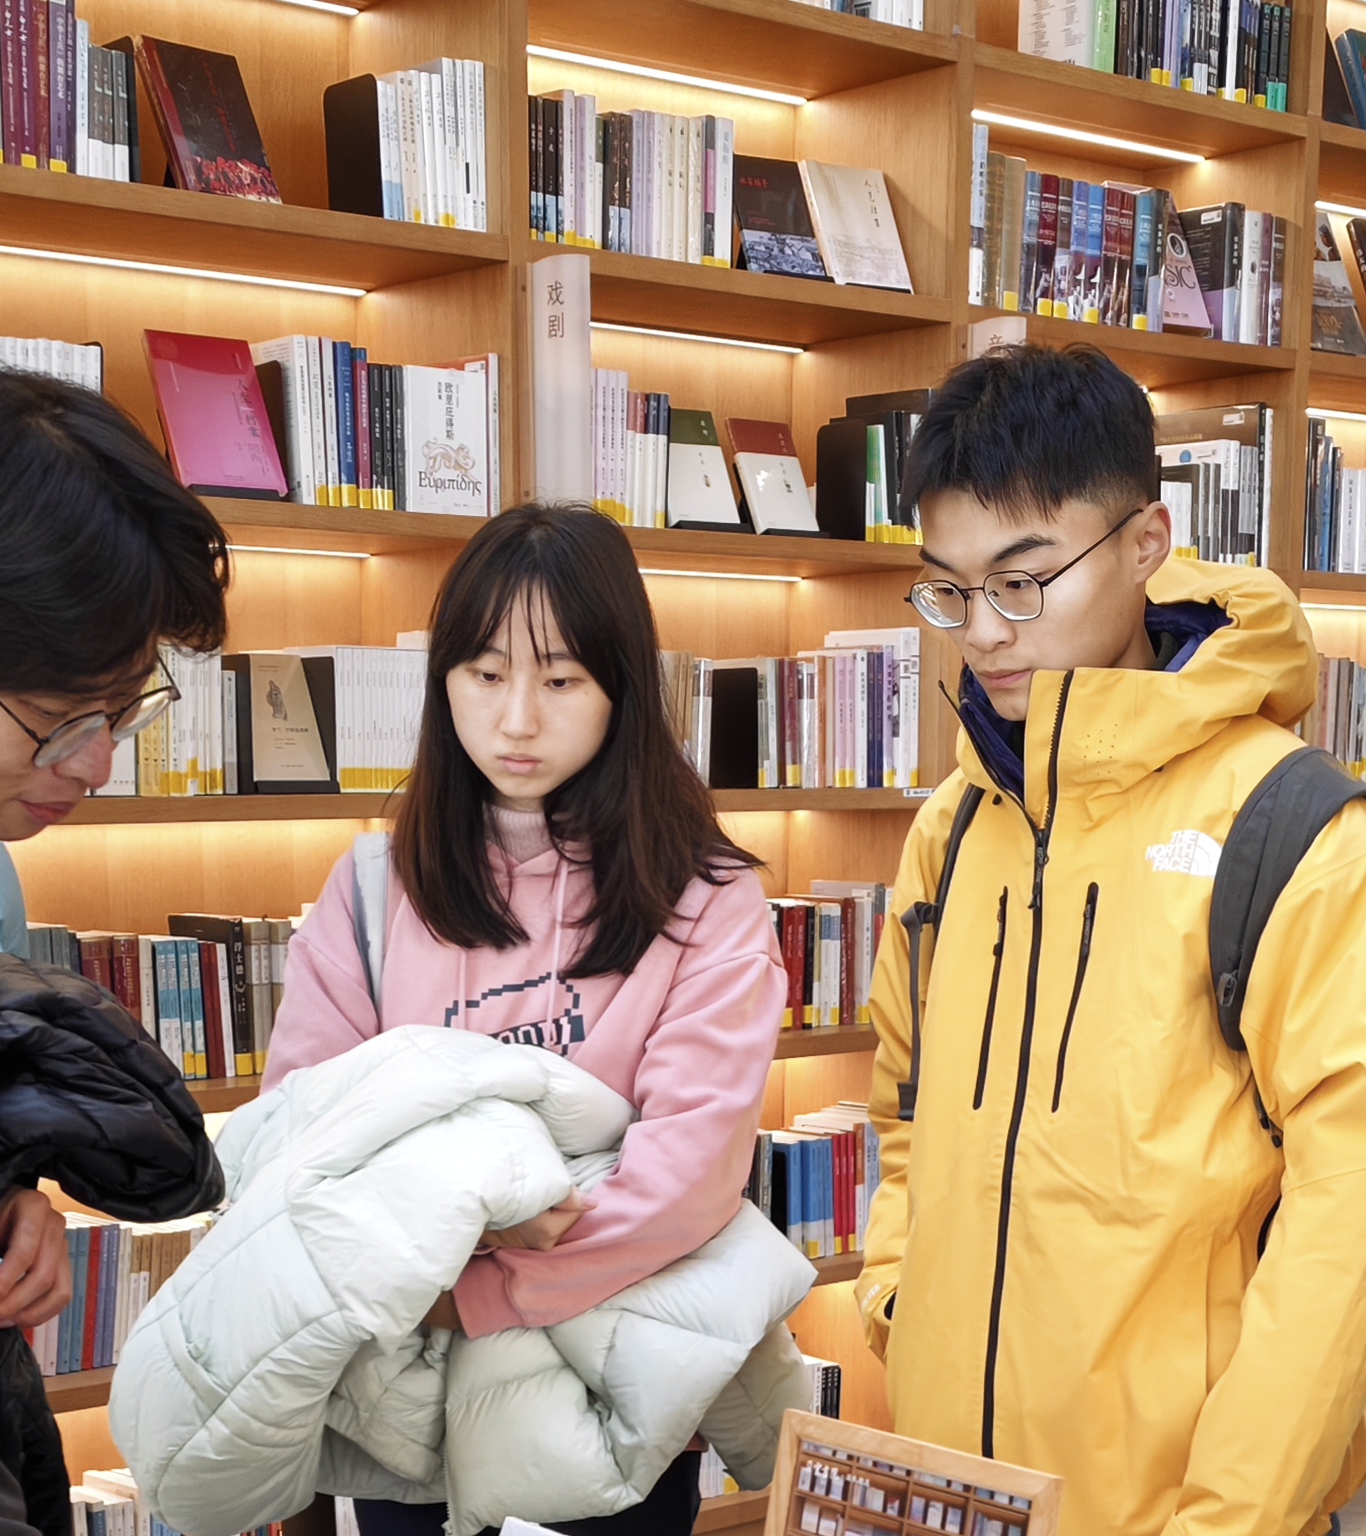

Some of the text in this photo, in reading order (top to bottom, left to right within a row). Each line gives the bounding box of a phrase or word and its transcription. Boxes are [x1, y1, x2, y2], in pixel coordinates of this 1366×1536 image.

[547, 280, 565, 338] 戏剧
[1171, 830, 1196, 844] THE
[1145, 843, 1194, 860] NORTH
[1153, 857, 1191, 874] FACE
